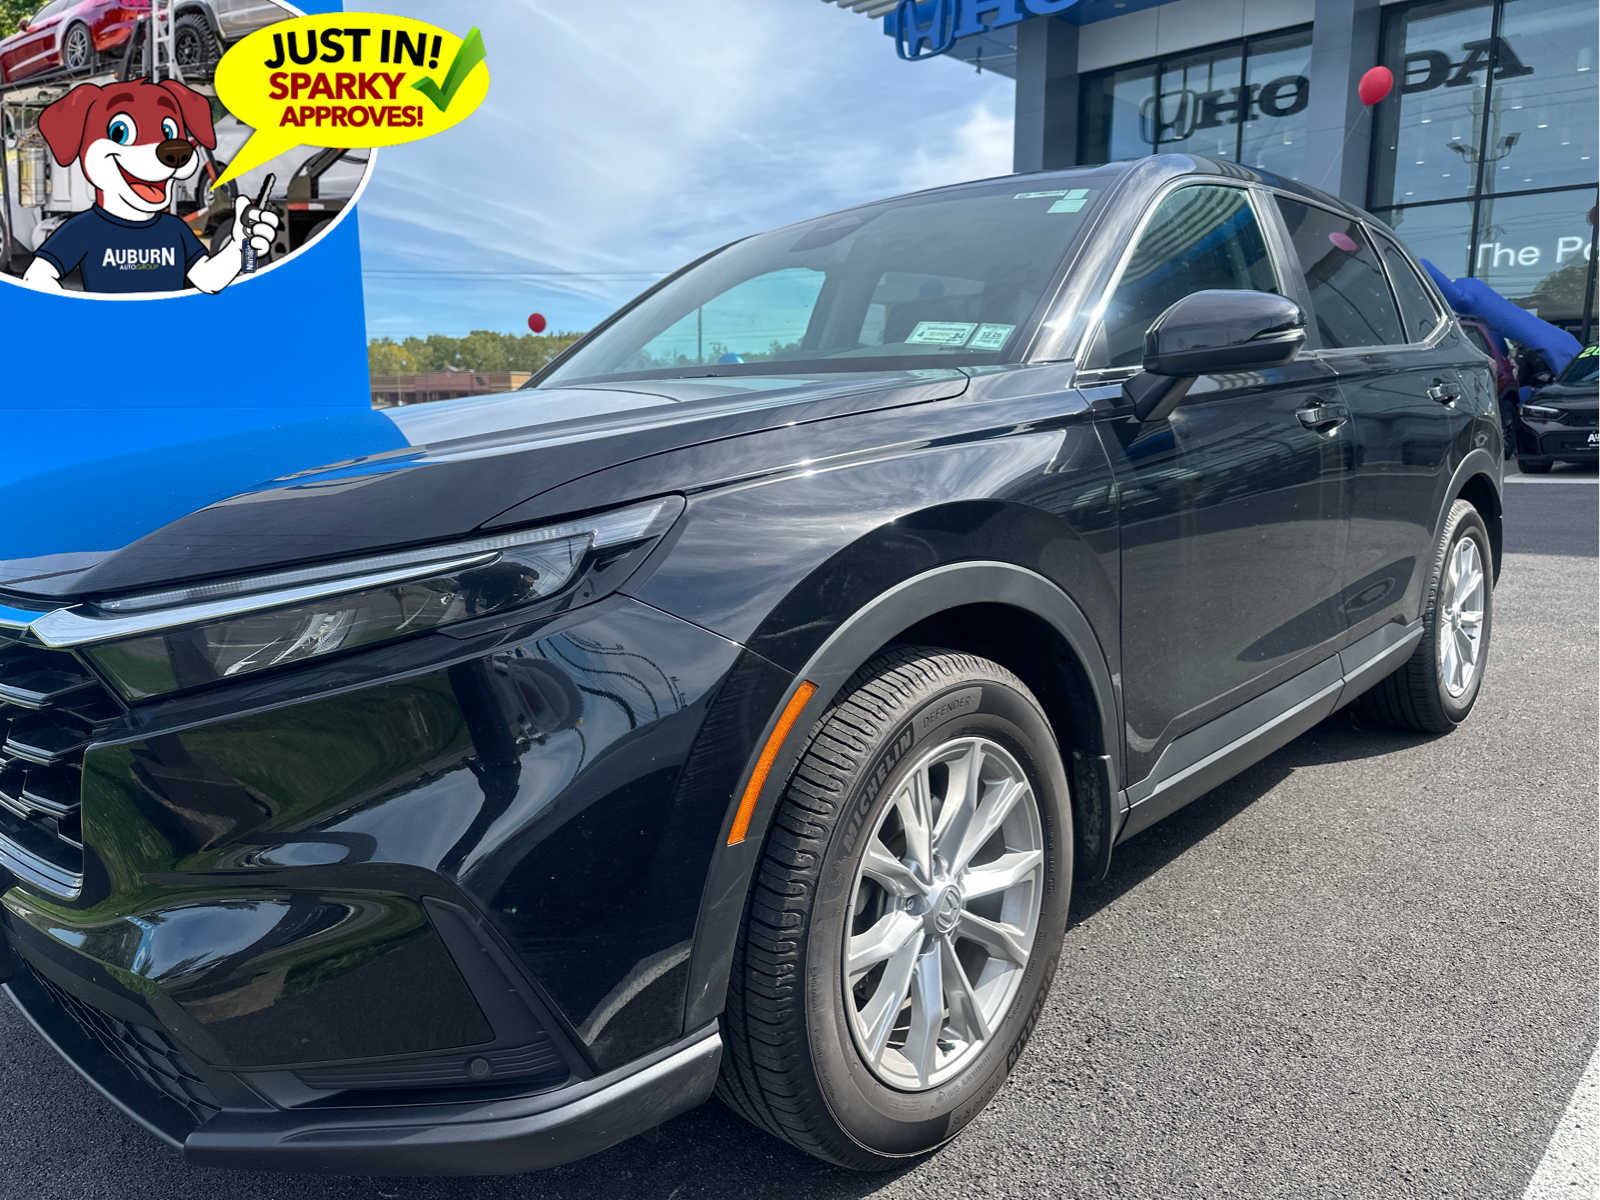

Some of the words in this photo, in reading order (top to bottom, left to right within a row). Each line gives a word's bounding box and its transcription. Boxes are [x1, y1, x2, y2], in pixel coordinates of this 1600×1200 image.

[1467, 241, 1540, 269] The
[922, 695, 972, 729] DEFENDER
[842, 728, 913, 852] MICHELIN
